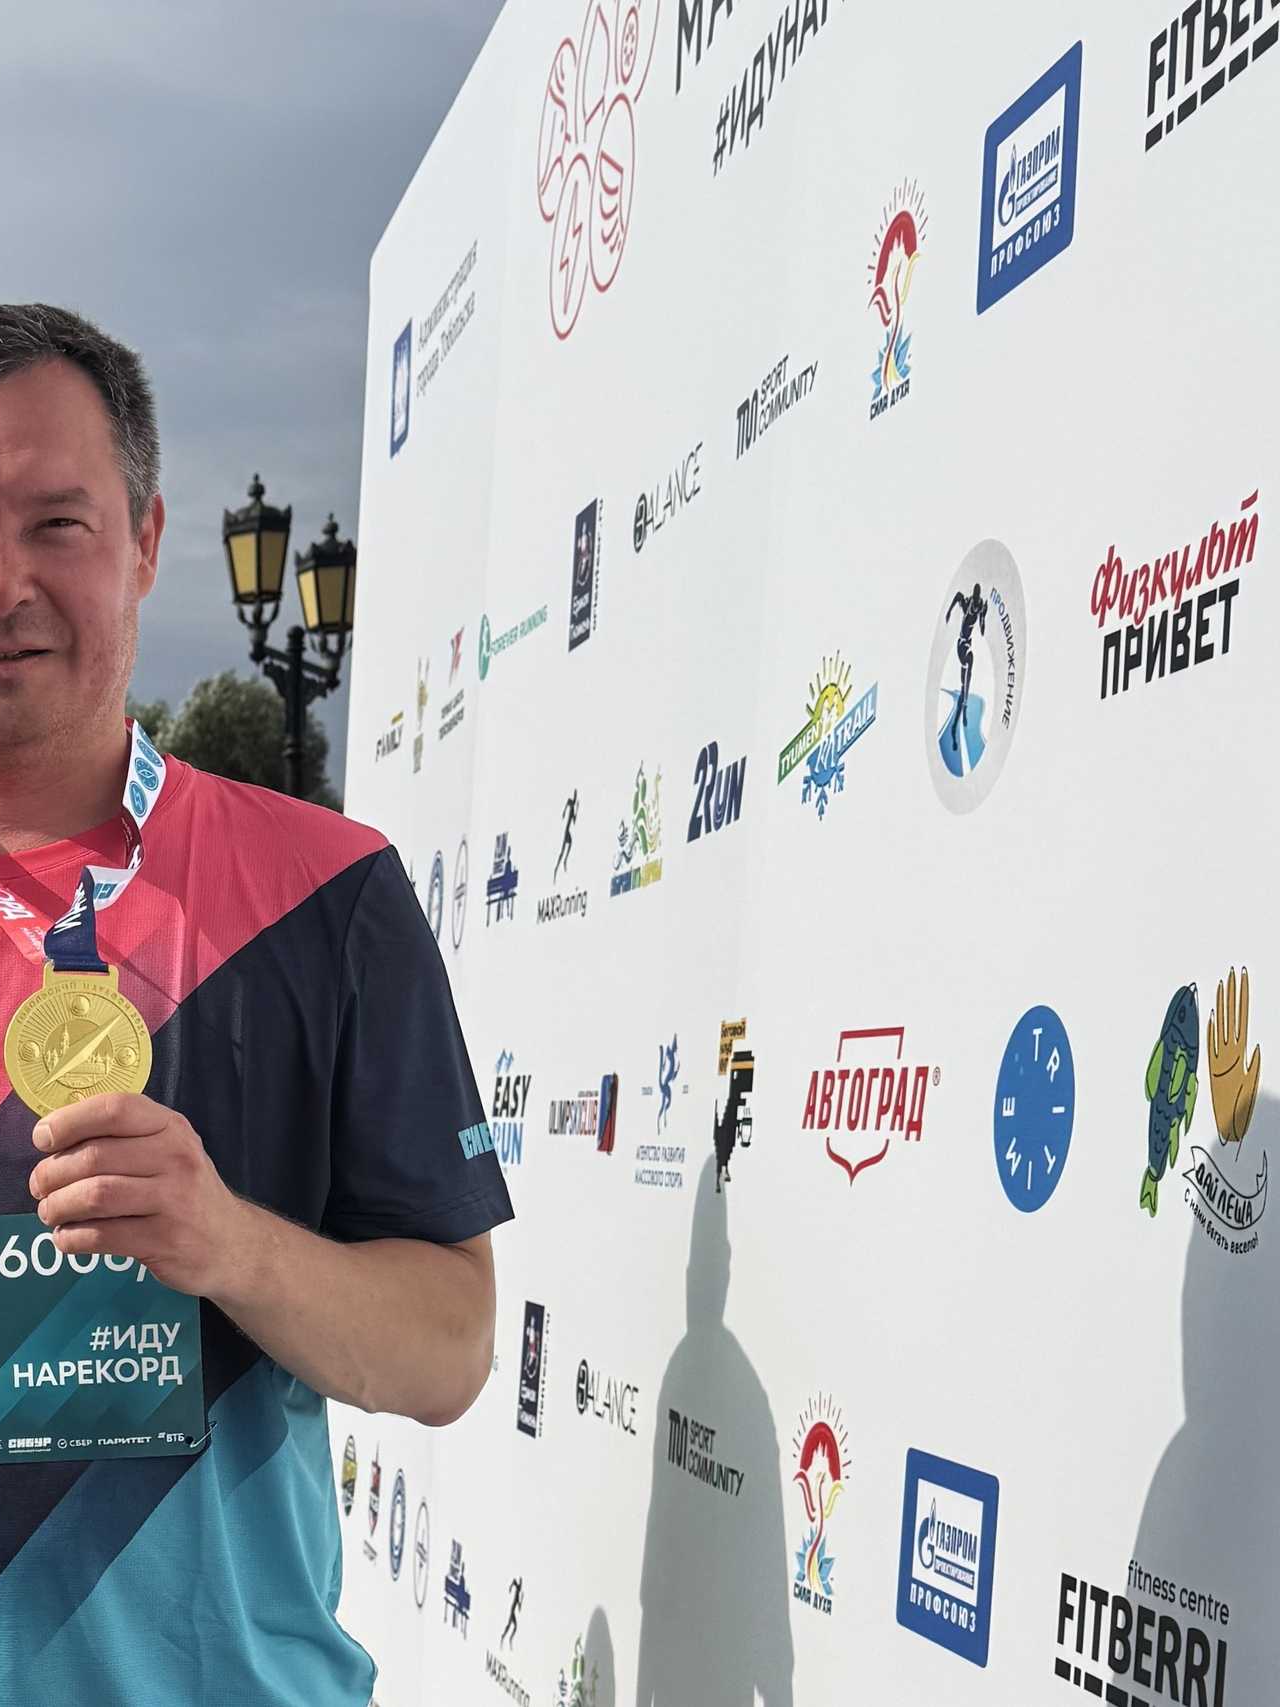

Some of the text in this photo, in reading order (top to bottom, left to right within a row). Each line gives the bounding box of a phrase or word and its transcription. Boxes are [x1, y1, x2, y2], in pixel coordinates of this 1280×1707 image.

[1147, 0, 1280, 118] FITBE
[1015, 125, 1061, 191] ГАЗПРОМ
[990, 203, 1061, 278] ПРОФСОЮЗ
[759, 360, 819, 436] COMMUNITY
[761, 354, 789, 403] SPORT
[1091, 488, 1259, 628] Физкульт
[990, 587, 1016, 730] ПРОДВИЖЕНИЕ
[1100, 578, 1240, 700] ПРИВЕТ
[835, 695, 875, 752] TRAIL
[492, 1074, 532, 1118] EASY
[802, 1066, 930, 1142] АВТОГРАД
[492, 1121, 523, 1165] RUN
[90, 1322, 181, 1354] #ИДУ
[13, 1356, 184, 1389] НАРЕКОРД
[8, 1437, 52, 1449] СИБУР
[69, 1438, 93, 1447] СБЕР
[97, 1436, 153, 1446] ПАРИТЕТ
[689, 1419, 717, 1454] SPORT
[688, 1450, 745, 1497] COMMUNITY
[935, 1519, 978, 1565] ГАЗПРОМ
[909, 1582, 977, 1633] ПРОФСОЮЗ
[1127, 1559, 1230, 1625] fitness centre
[1056, 1572, 1228, 1707] FITBERRI
